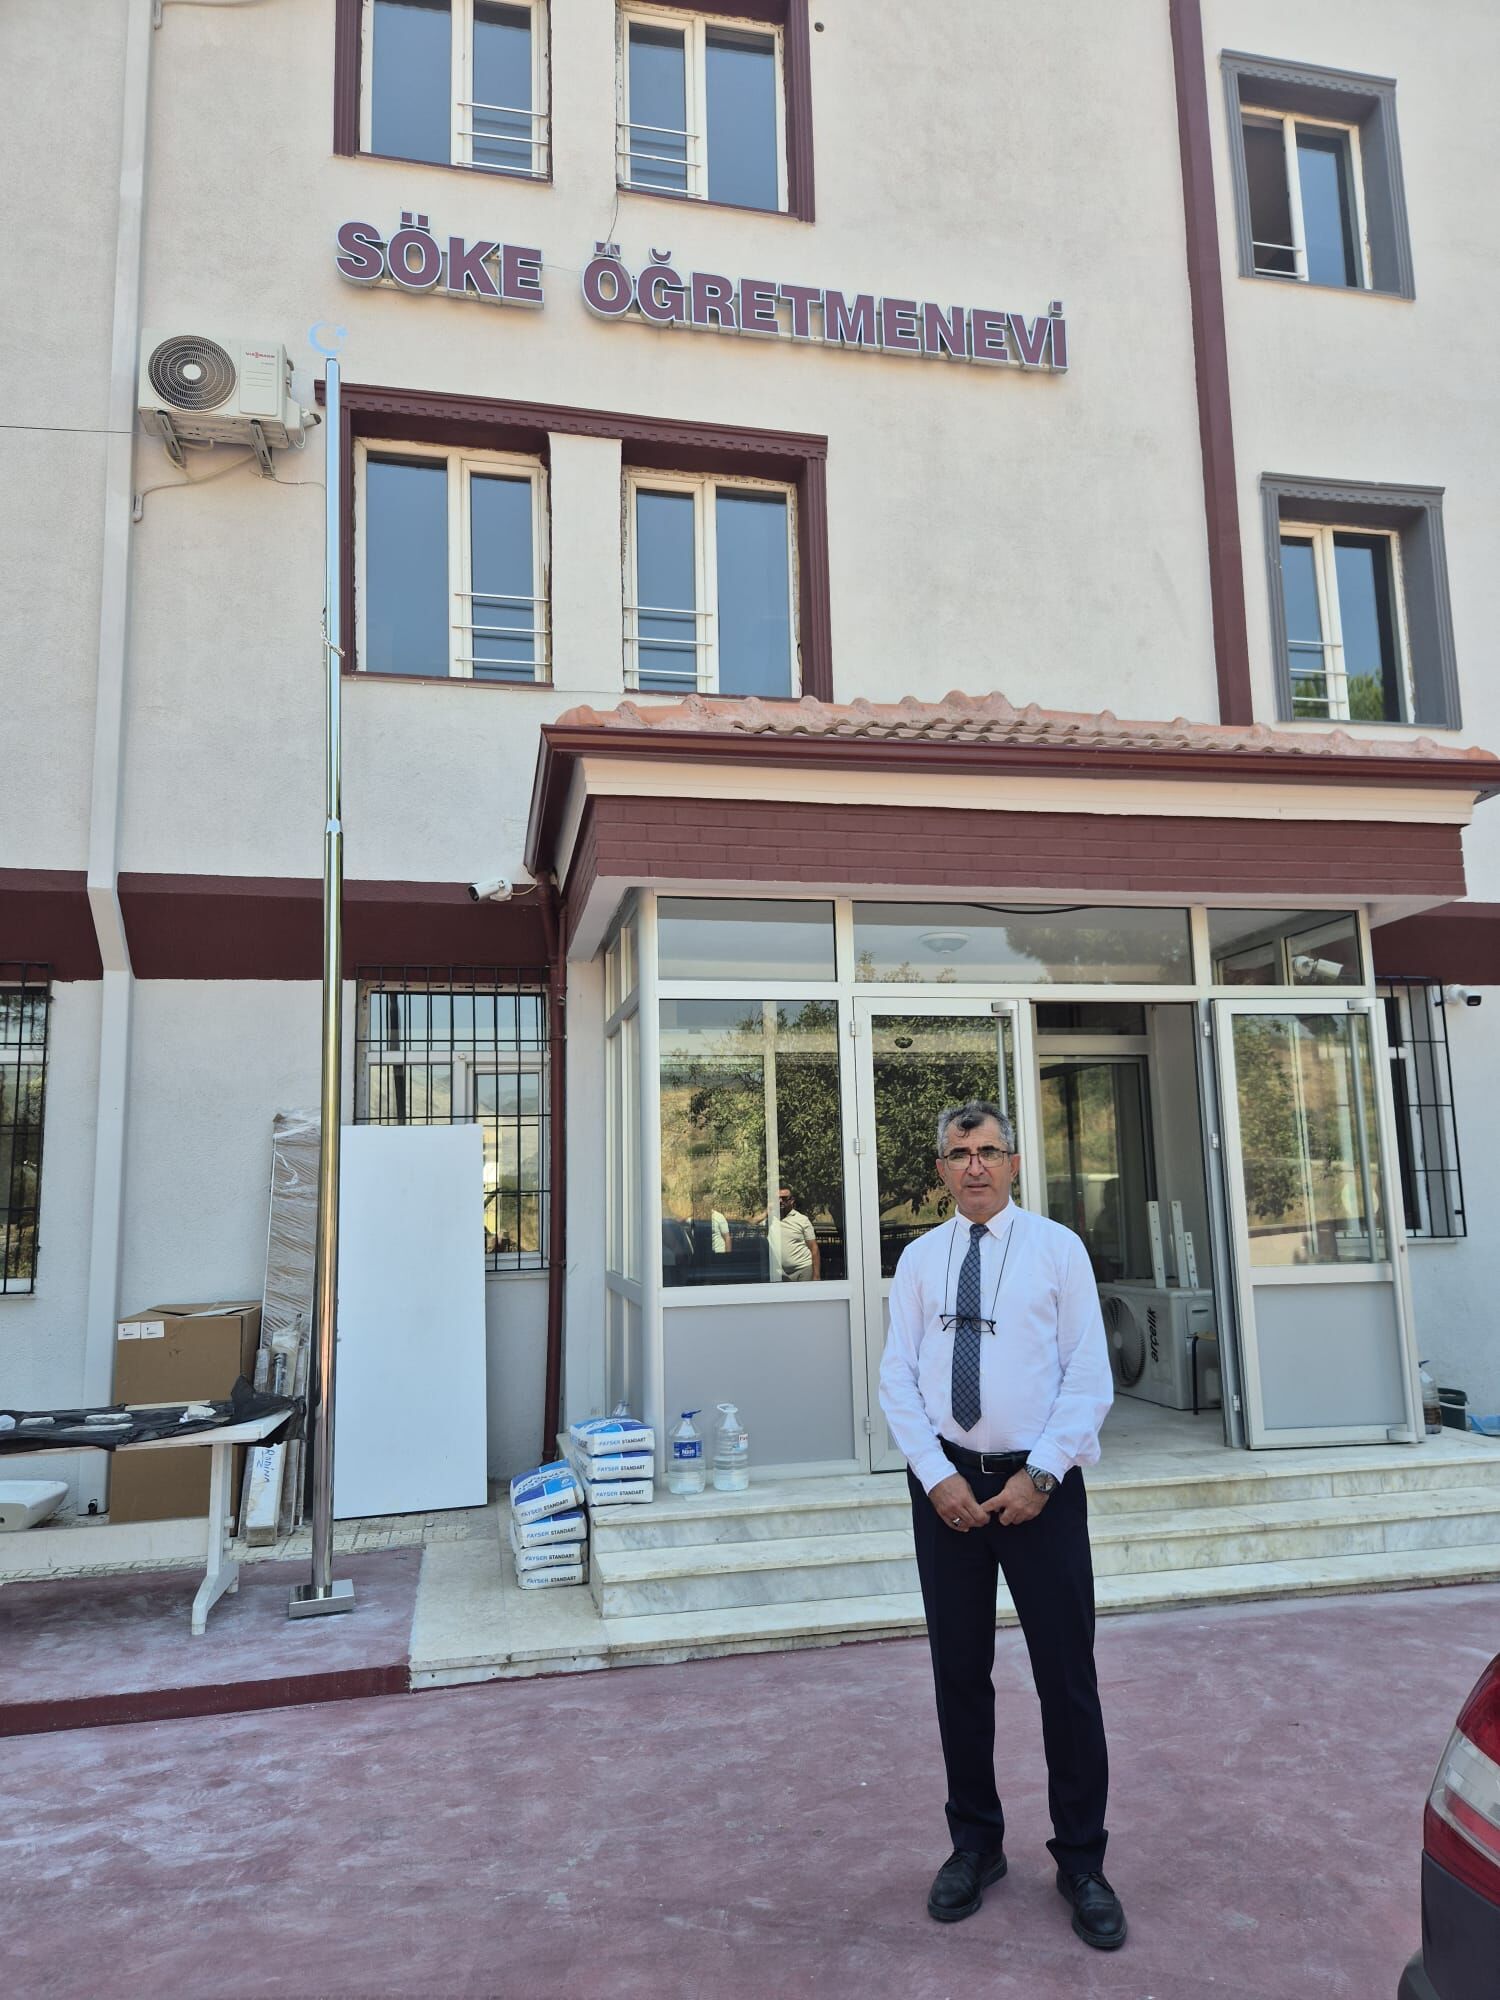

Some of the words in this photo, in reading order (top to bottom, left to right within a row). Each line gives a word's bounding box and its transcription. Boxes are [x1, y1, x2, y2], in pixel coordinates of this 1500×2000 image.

[335, 211, 543, 307] SÖKE
[580, 240, 1067, 372] ÖĞRETMENEVİ
[621, 1437, 646, 1445] STANDART
[543, 1499, 569, 1511] STANDART
[550, 1527, 577, 1535] STANDART
